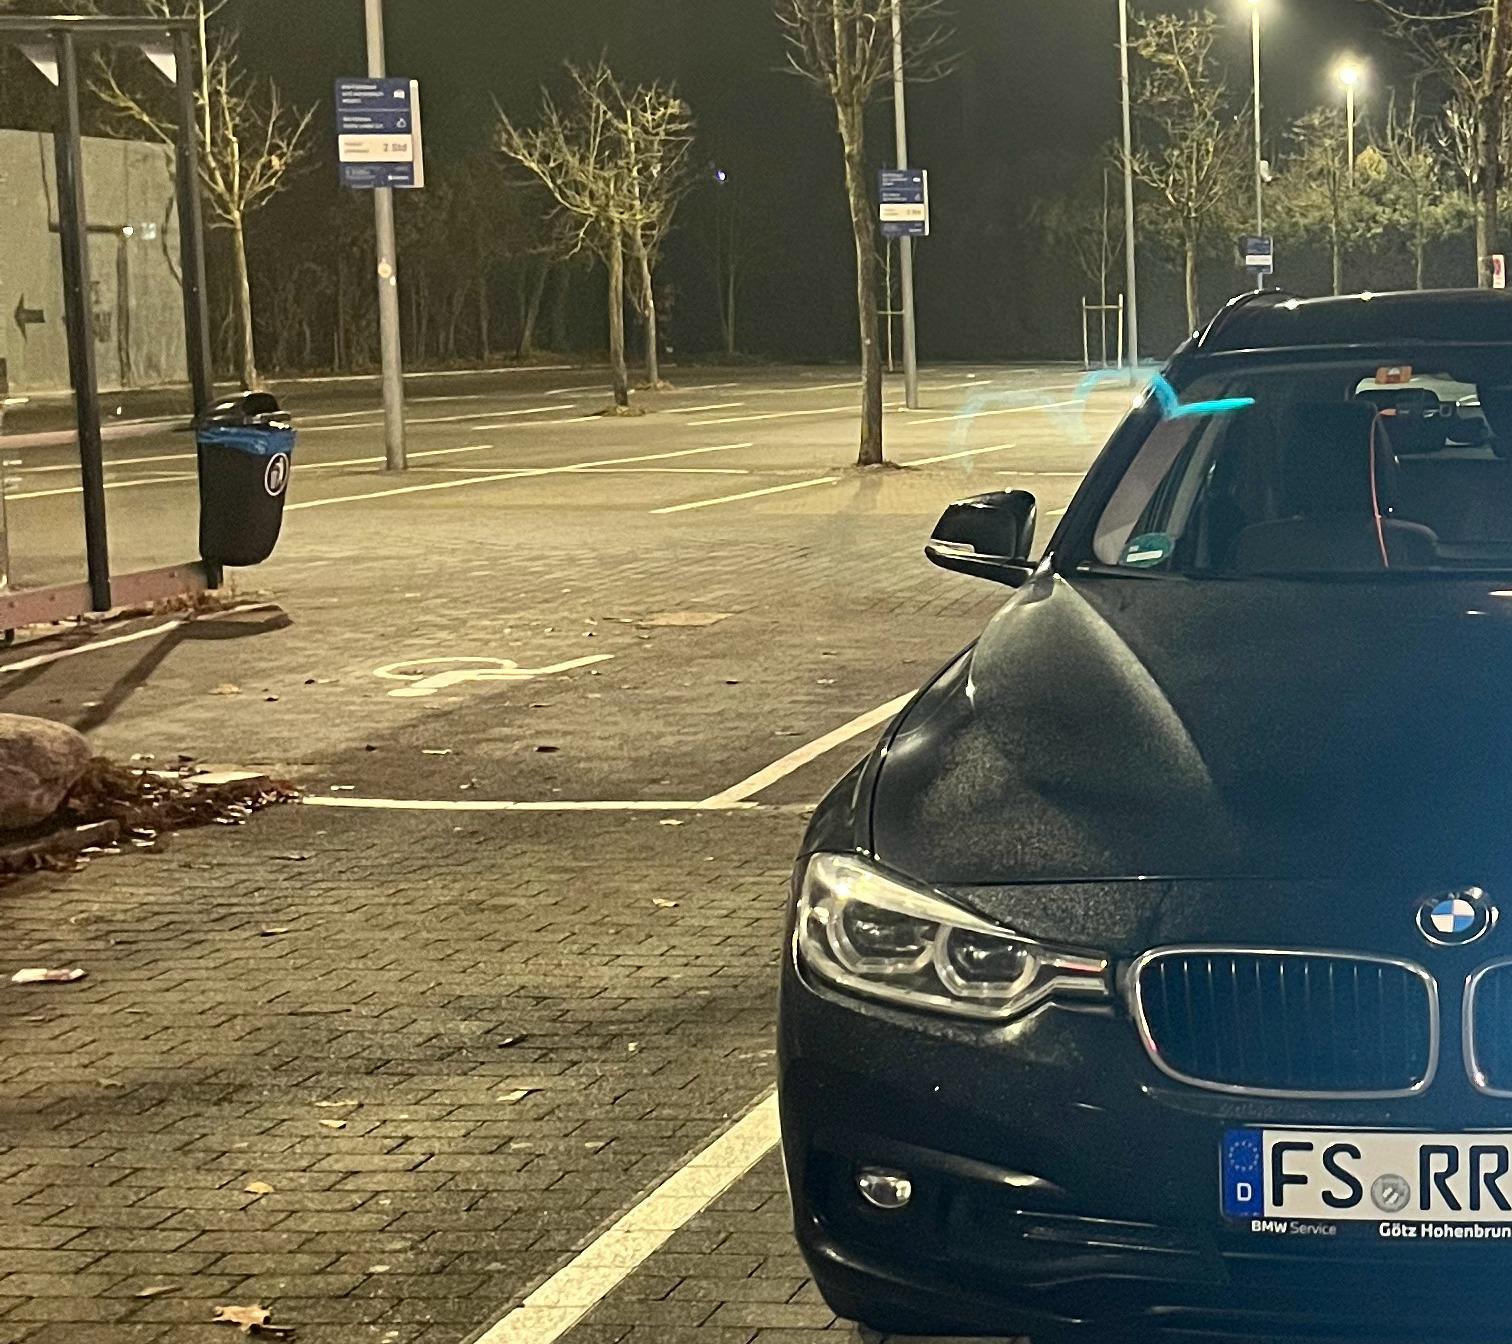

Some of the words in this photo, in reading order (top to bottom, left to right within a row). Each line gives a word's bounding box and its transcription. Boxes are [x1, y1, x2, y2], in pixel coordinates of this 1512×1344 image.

[1271, 1141, 1364, 1209] FS
[1419, 1144, 1512, 1211] RR
[1236, 1182, 1252, 1202] D
[1251, 1220, 1288, 1234] BMW
[1290, 1221, 1337, 1236] Service
[1379, 1222, 1417, 1238] Götz
